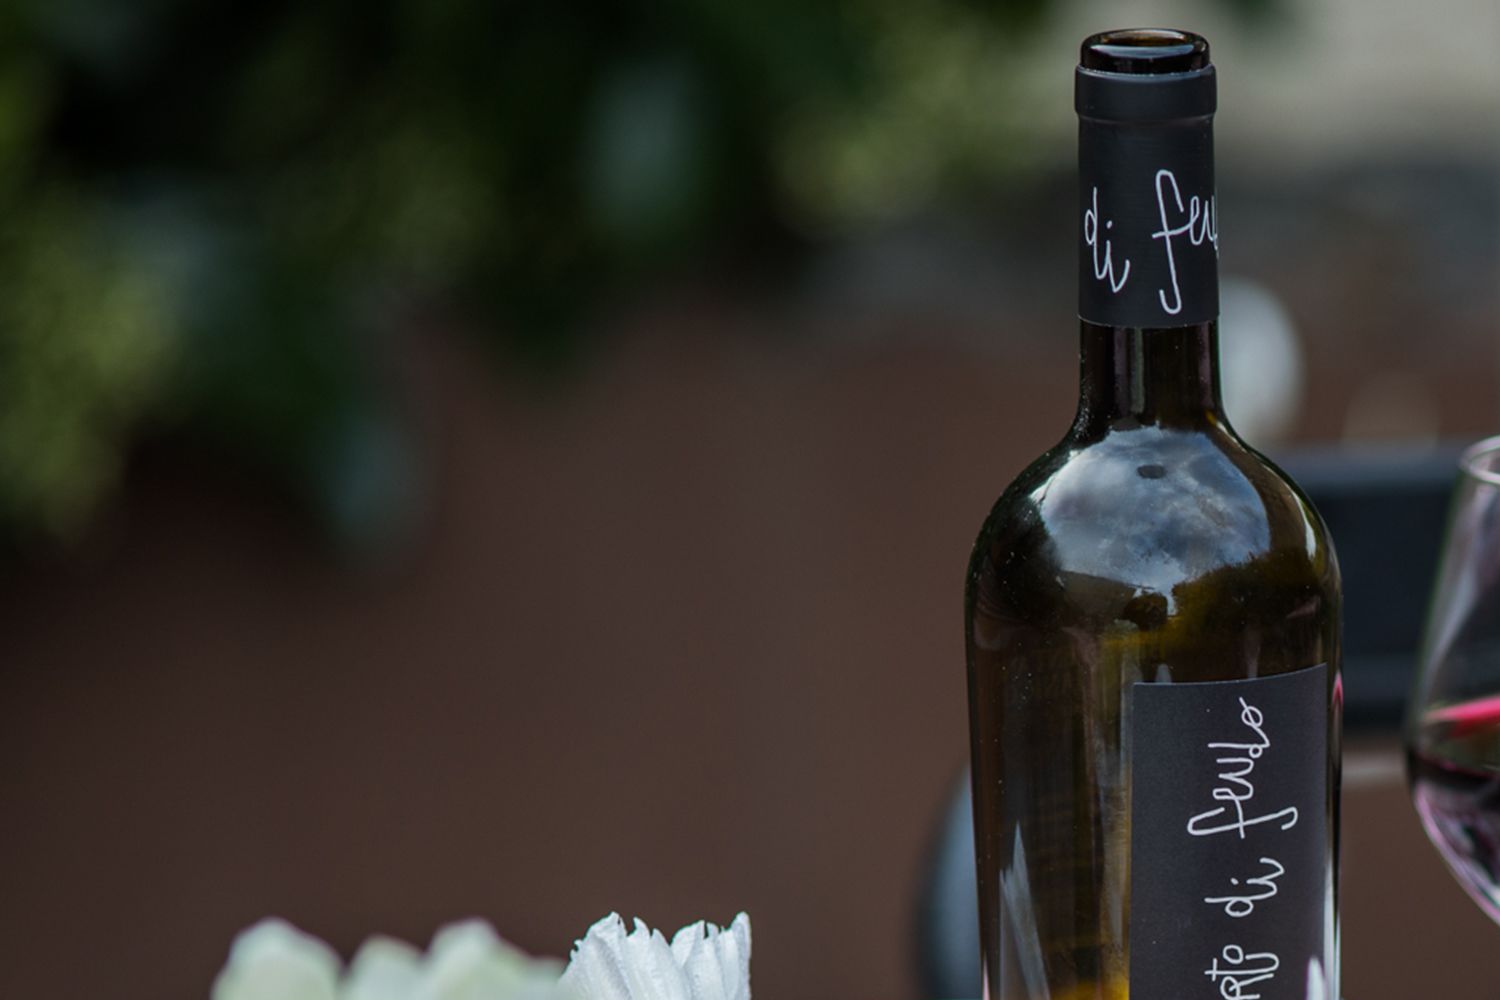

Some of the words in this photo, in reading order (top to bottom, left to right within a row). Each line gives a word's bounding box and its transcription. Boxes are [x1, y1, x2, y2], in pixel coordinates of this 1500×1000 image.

[1084, 186, 1131, 293] di
[1151, 169, 1218, 315] feu
[1187, 697, 1299, 839] feudo
[1204, 857, 1286, 917] di
